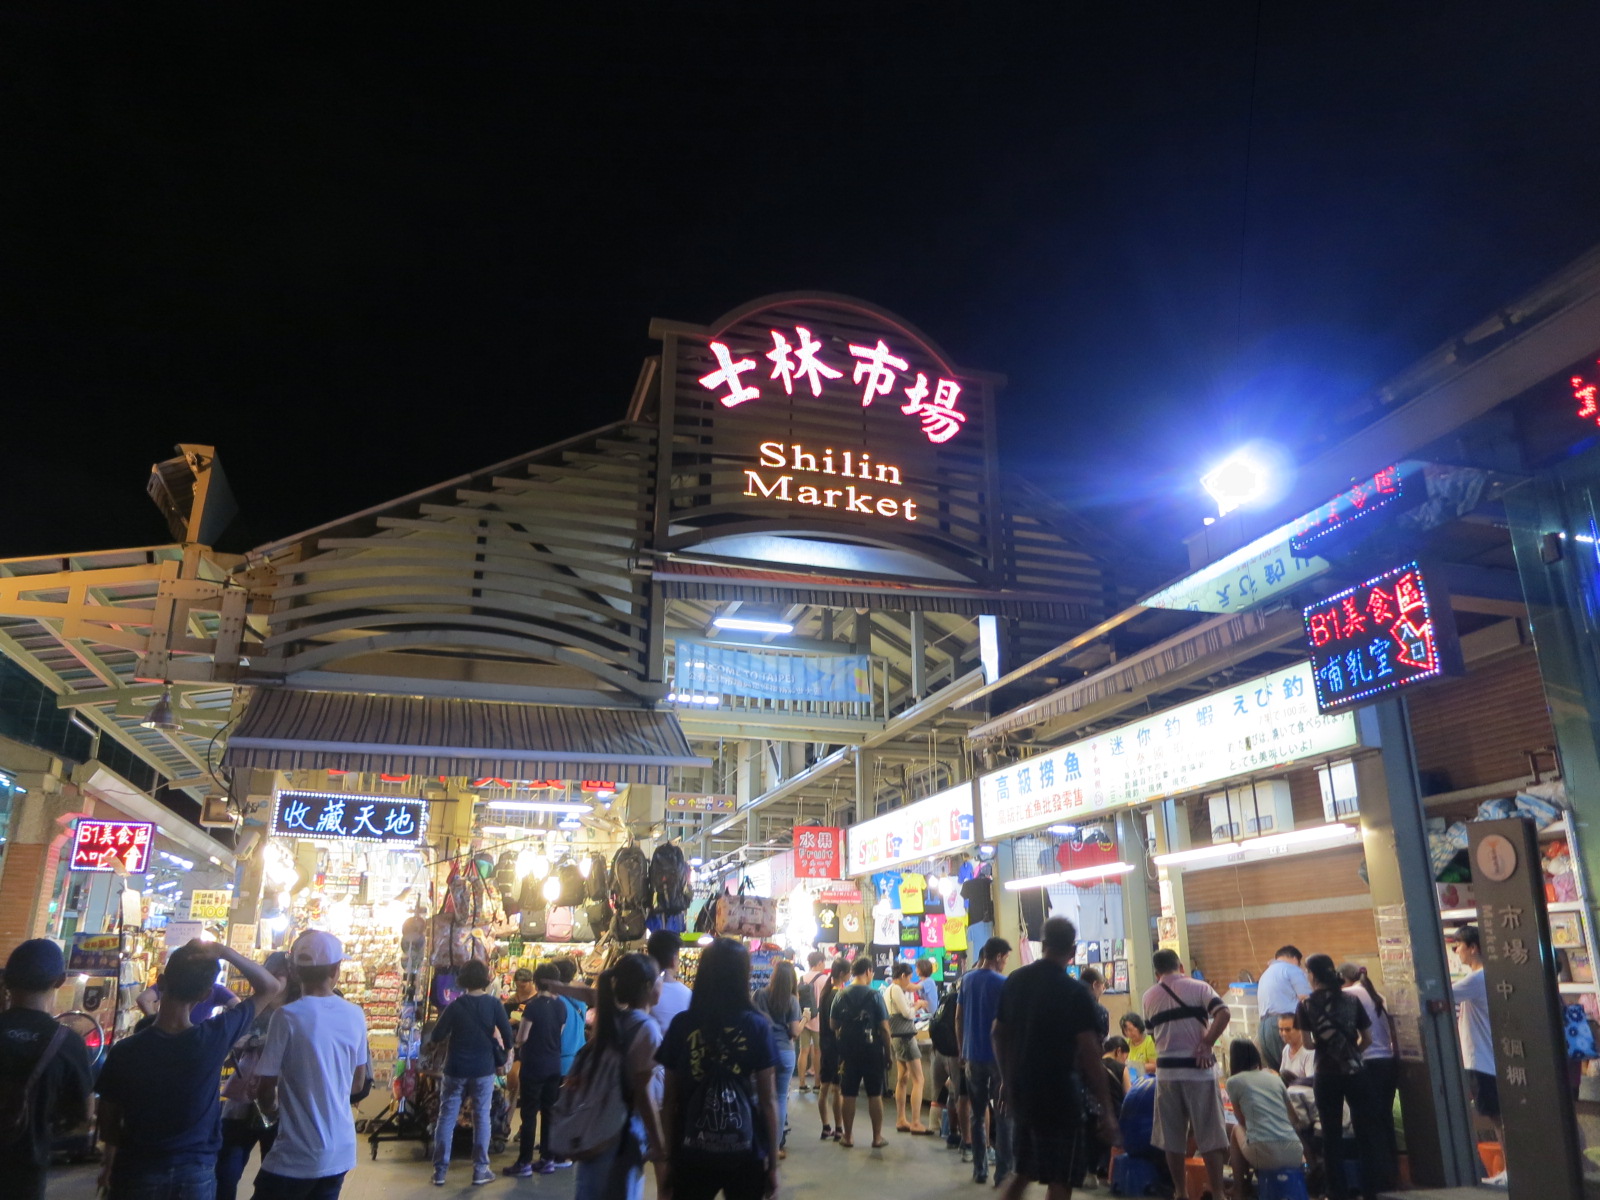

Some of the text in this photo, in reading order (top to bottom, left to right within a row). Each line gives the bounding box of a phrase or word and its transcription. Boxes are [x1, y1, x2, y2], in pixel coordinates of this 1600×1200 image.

[699, 326, 967, 443] 士林市場
[759, 442, 902, 485] Shilin
[743, 470, 918, 522] Market
[1310, 573, 1423, 647] B1美食區
[1320, 638, 1393, 692] 哺乳室
[1109, 704, 1214, 757] 迷你釣蝦
[994, 750, 1083, 803] 高級撈魚
[78, 824, 148, 845] B1美食區
[284, 799, 415, 836] 收藏天地
[799, 831, 833, 848] 水果
[76, 850, 98, 861] 入口
[799, 848, 834, 859] Fruit
[1482, 903, 1499, 961] Market
[1498, 904, 1530, 965] 市場
